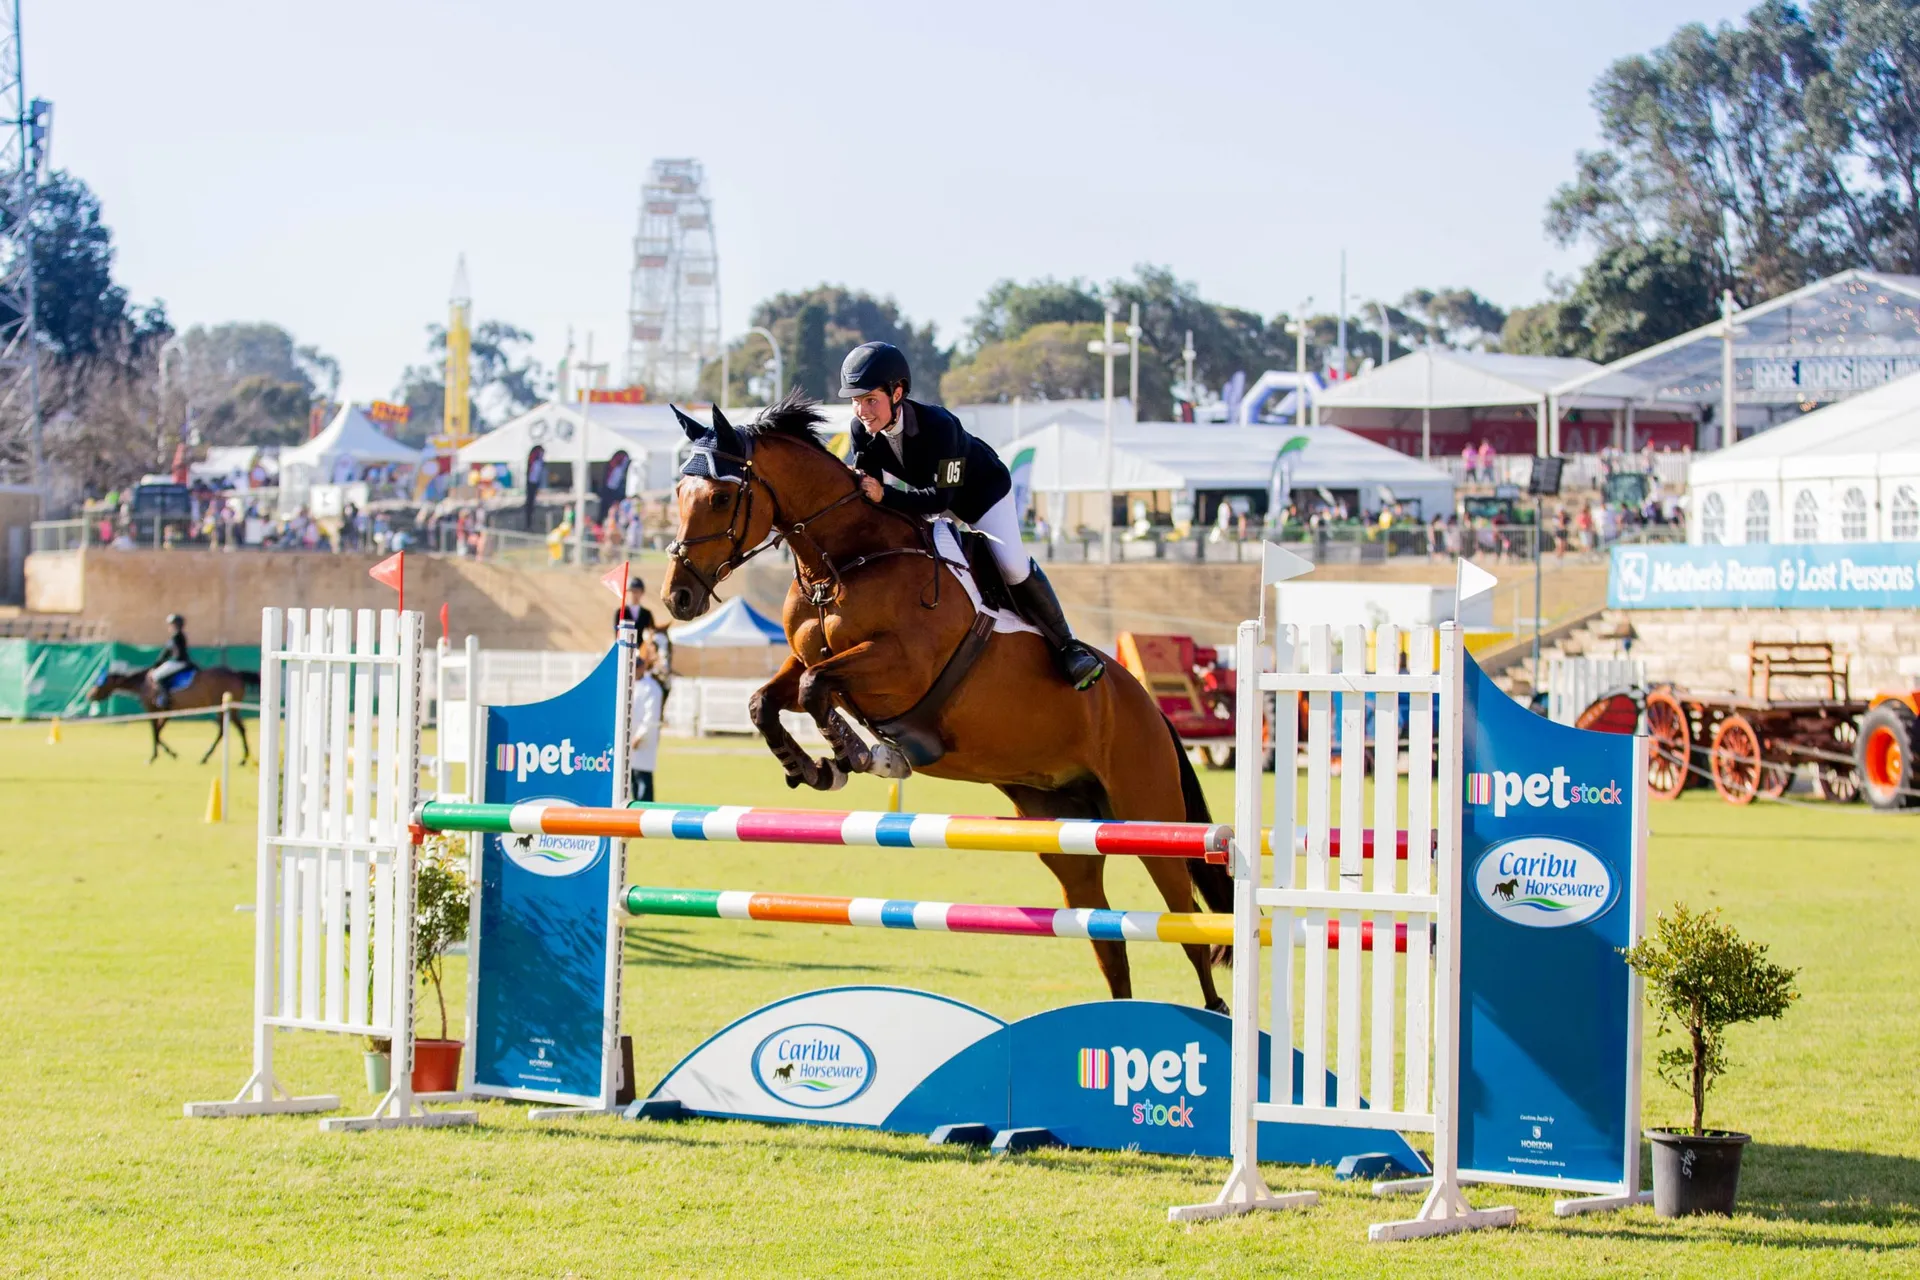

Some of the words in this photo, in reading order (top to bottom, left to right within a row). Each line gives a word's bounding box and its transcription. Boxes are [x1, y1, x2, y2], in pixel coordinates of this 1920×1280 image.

[946, 461, 961, 484] 05
[1726, 559, 1776, 591] Room
[1779, 558, 1795, 590] &
[1798, 559, 1837, 591] Lost
[1840, 558, 1914, 591] Persons
[538, 834, 596, 852] Horseware
[1500, 852, 1577, 878] Caribu
[1525, 878, 1604, 898] Horseware
[778, 1039, 841, 1061] Caribu
[800, 1063, 863, 1079] Horseware
[1110, 1041, 1207, 1106] pet
[1132, 1095, 1194, 1128] stock
[1521, 1140, 1553, 1150] HORIZON
